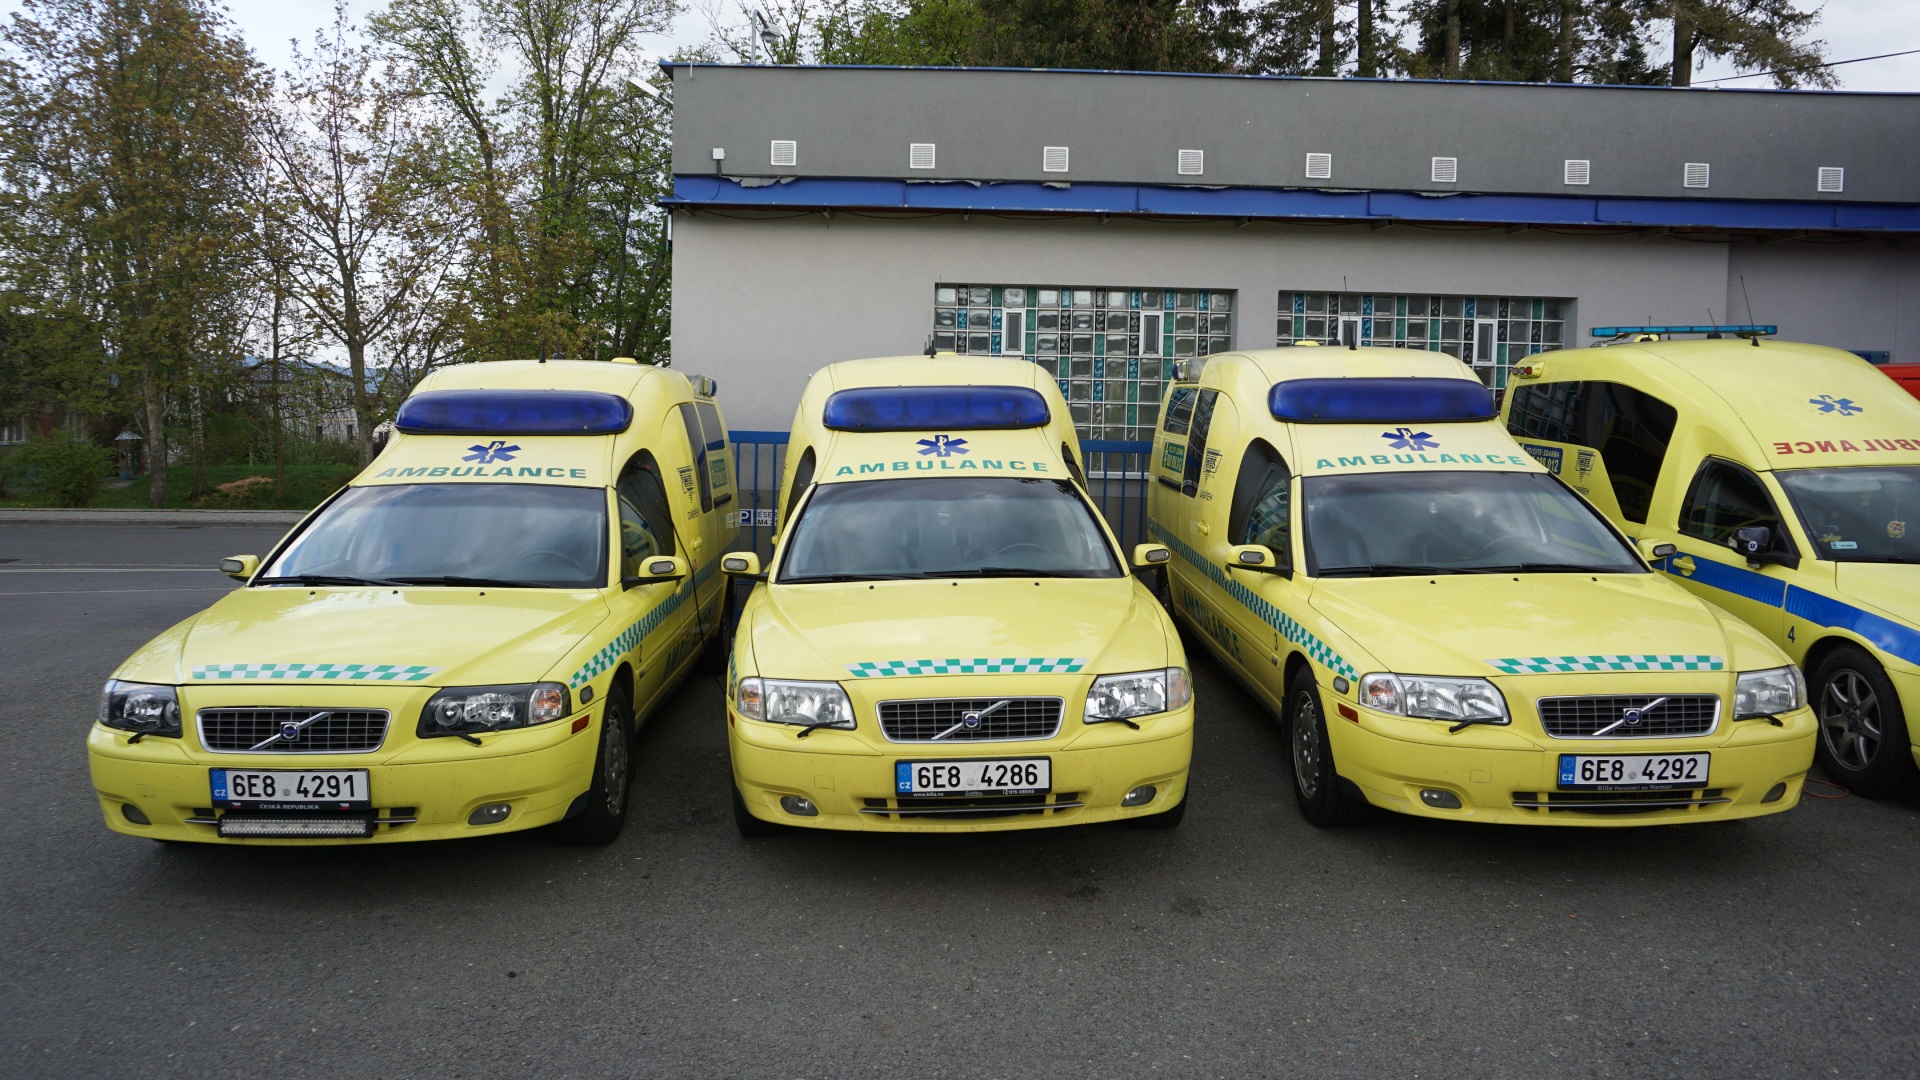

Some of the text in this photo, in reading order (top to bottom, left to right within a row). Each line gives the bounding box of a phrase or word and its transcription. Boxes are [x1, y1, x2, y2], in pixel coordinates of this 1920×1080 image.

[836, 459, 1048, 476] AMBULANCE
[1316, 453, 1526, 470] AMBULANCE
[374, 467, 587, 479] AMBULANCE
[1788, 626, 1795, 643] 4
[917, 763, 1038, 789] 6E8 4286
[1581, 757, 1698, 782] 6E8 4292
[214, 789, 226, 797] CZ
[232, 774, 355, 798] 6E8 4291
